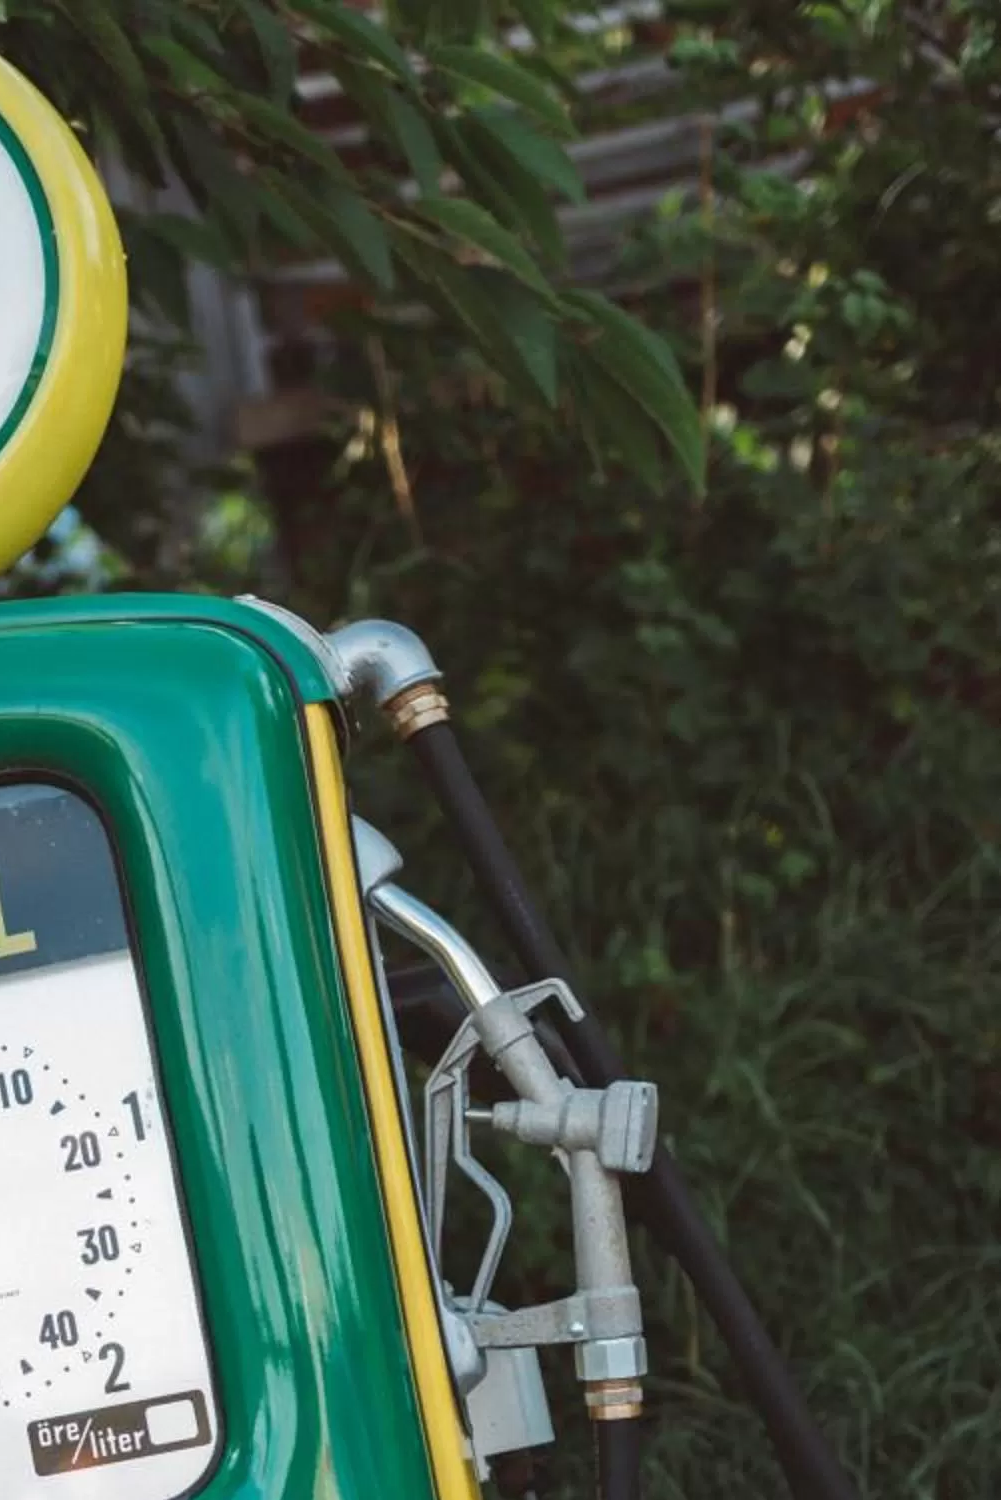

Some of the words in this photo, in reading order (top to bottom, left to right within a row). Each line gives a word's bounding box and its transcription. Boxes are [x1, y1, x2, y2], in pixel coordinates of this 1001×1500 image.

[122, 1091, 145, 1141] 1
[60, 1131, 101, 1172] 20
[77, 1225, 119, 1265] 30
[39, 1310, 78, 1350] 40
[99, 1342, 131, 1394] 2
[36, 1417, 146, 1465] öre/liter
